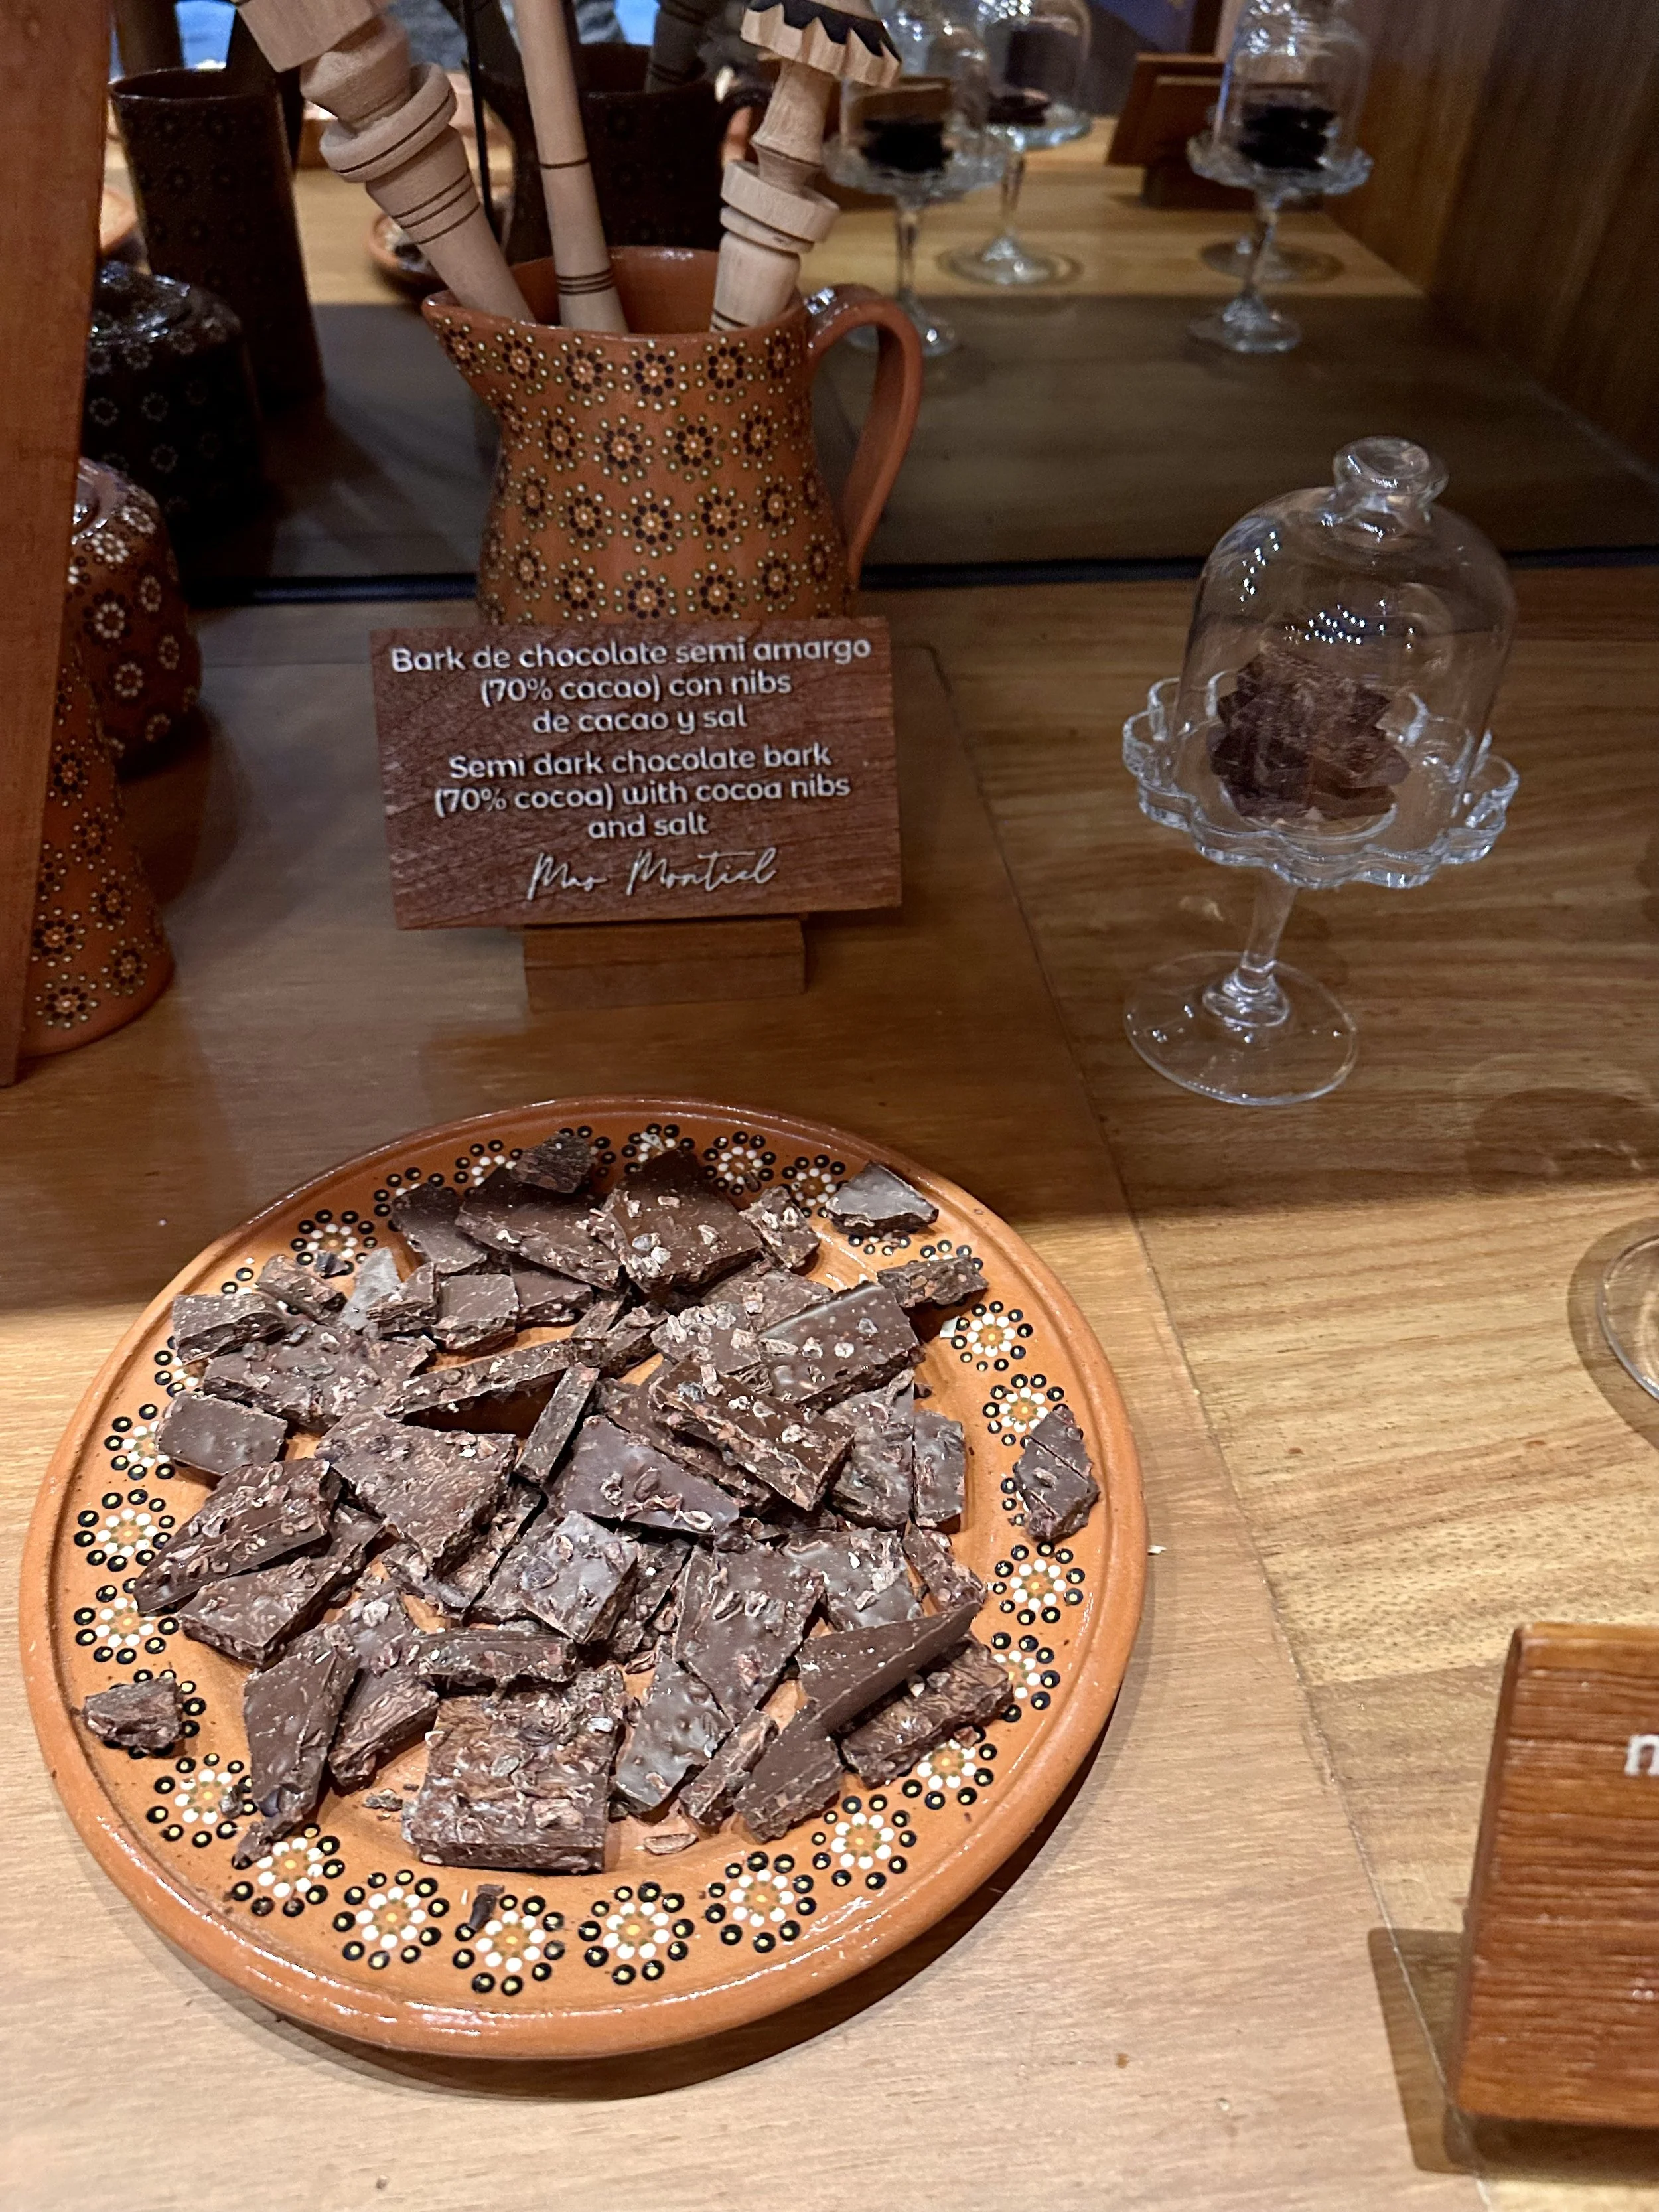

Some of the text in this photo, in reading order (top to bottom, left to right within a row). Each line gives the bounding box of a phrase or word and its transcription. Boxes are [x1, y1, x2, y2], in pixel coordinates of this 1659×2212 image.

[391, 635, 871, 672] Bark de chocolate semi amargo
[480, 668, 792, 708] (70% cacao) con nibs
[532, 703, 747, 735] de cacao y sal
[448, 741, 831, 779] Semi dark chocolate bark
[434, 773, 851, 818] (70% cocoa) with cocoa nibs
[587, 810, 709, 839] and salt
